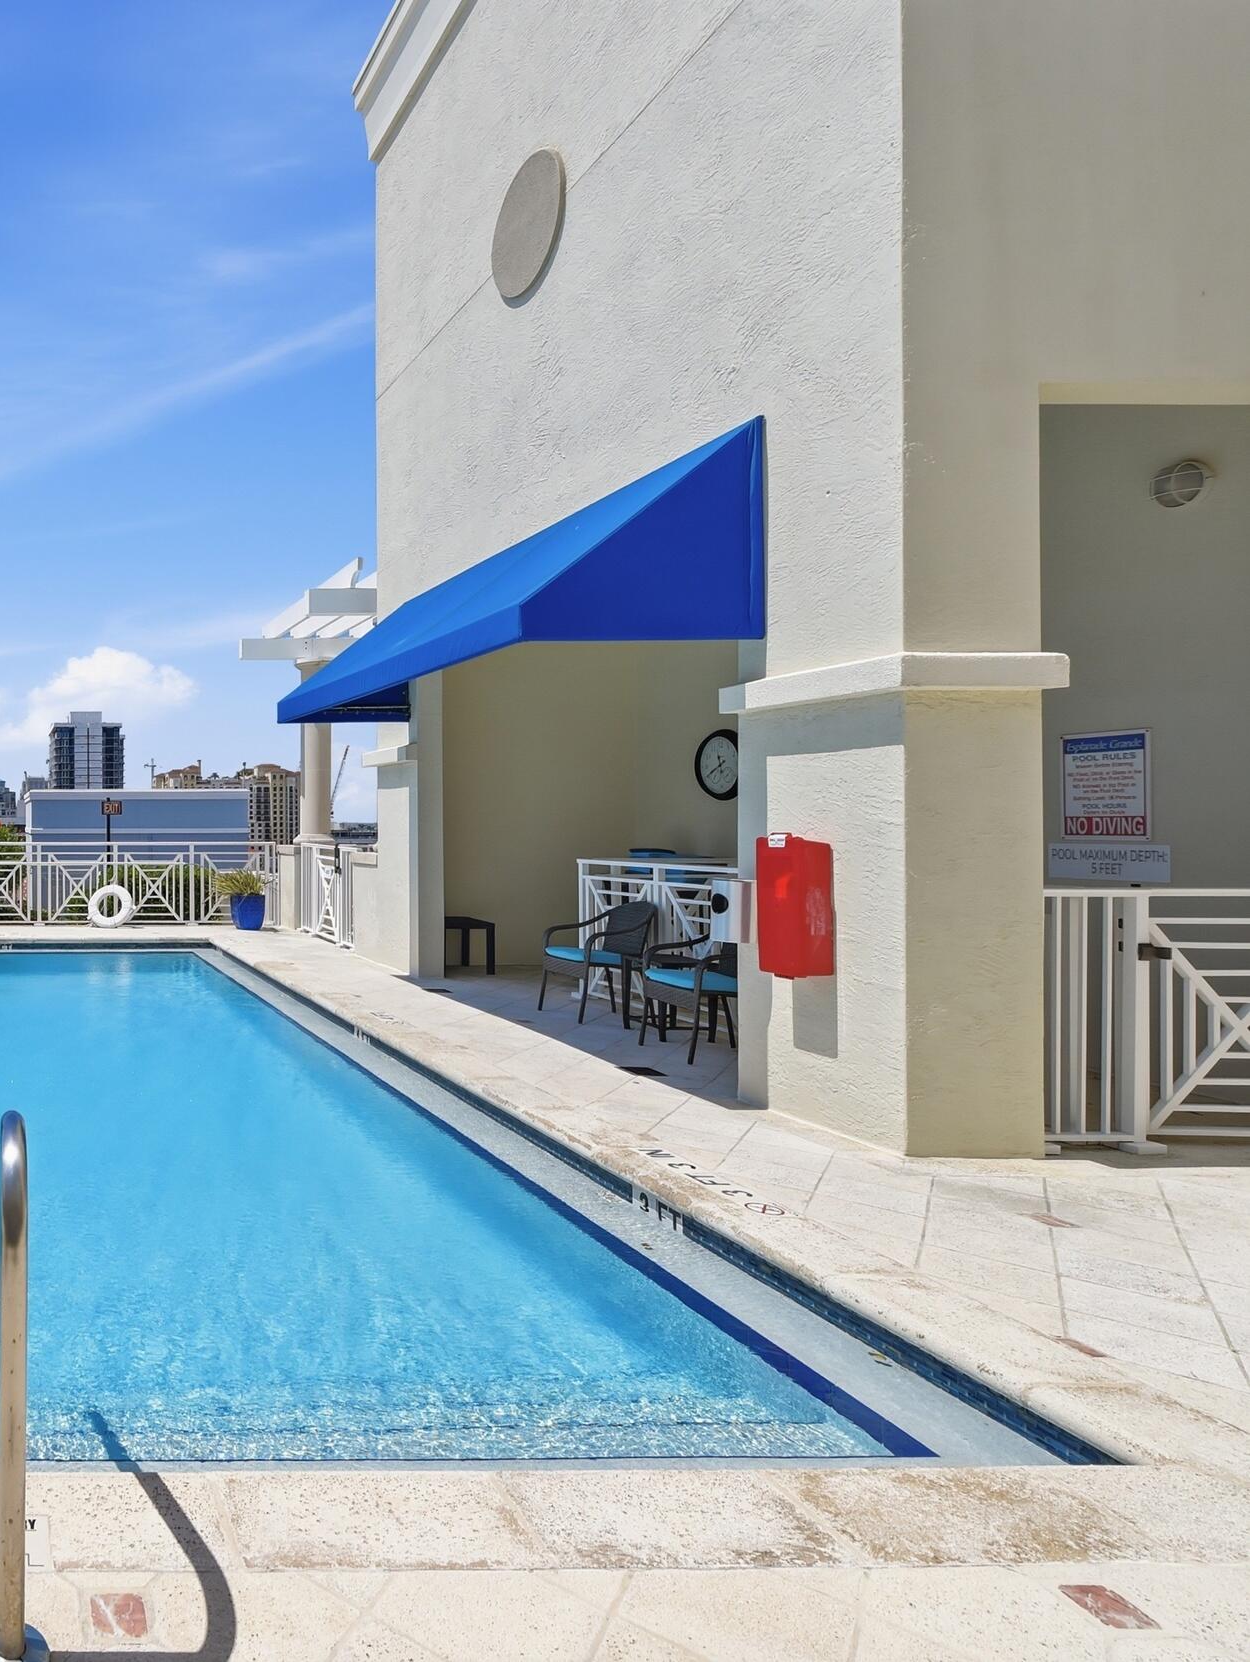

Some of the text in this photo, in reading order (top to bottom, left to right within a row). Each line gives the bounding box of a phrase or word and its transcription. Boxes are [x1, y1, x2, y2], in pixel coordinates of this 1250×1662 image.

[1109, 737, 1143, 749] Grande
[1102, 752, 1136, 761] RULES
[1066, 816, 1145, 835] NO DIVING
[1051, 848, 1078, 860] POOL
[1079, 849, 1127, 862] MAXIMUM
[1091, 862, 1123, 876] 5 FEET
[638, 1149, 675, 1158] IN
[684, 1173, 731, 1186] FT
[657, 1200, 681, 1232] FT
